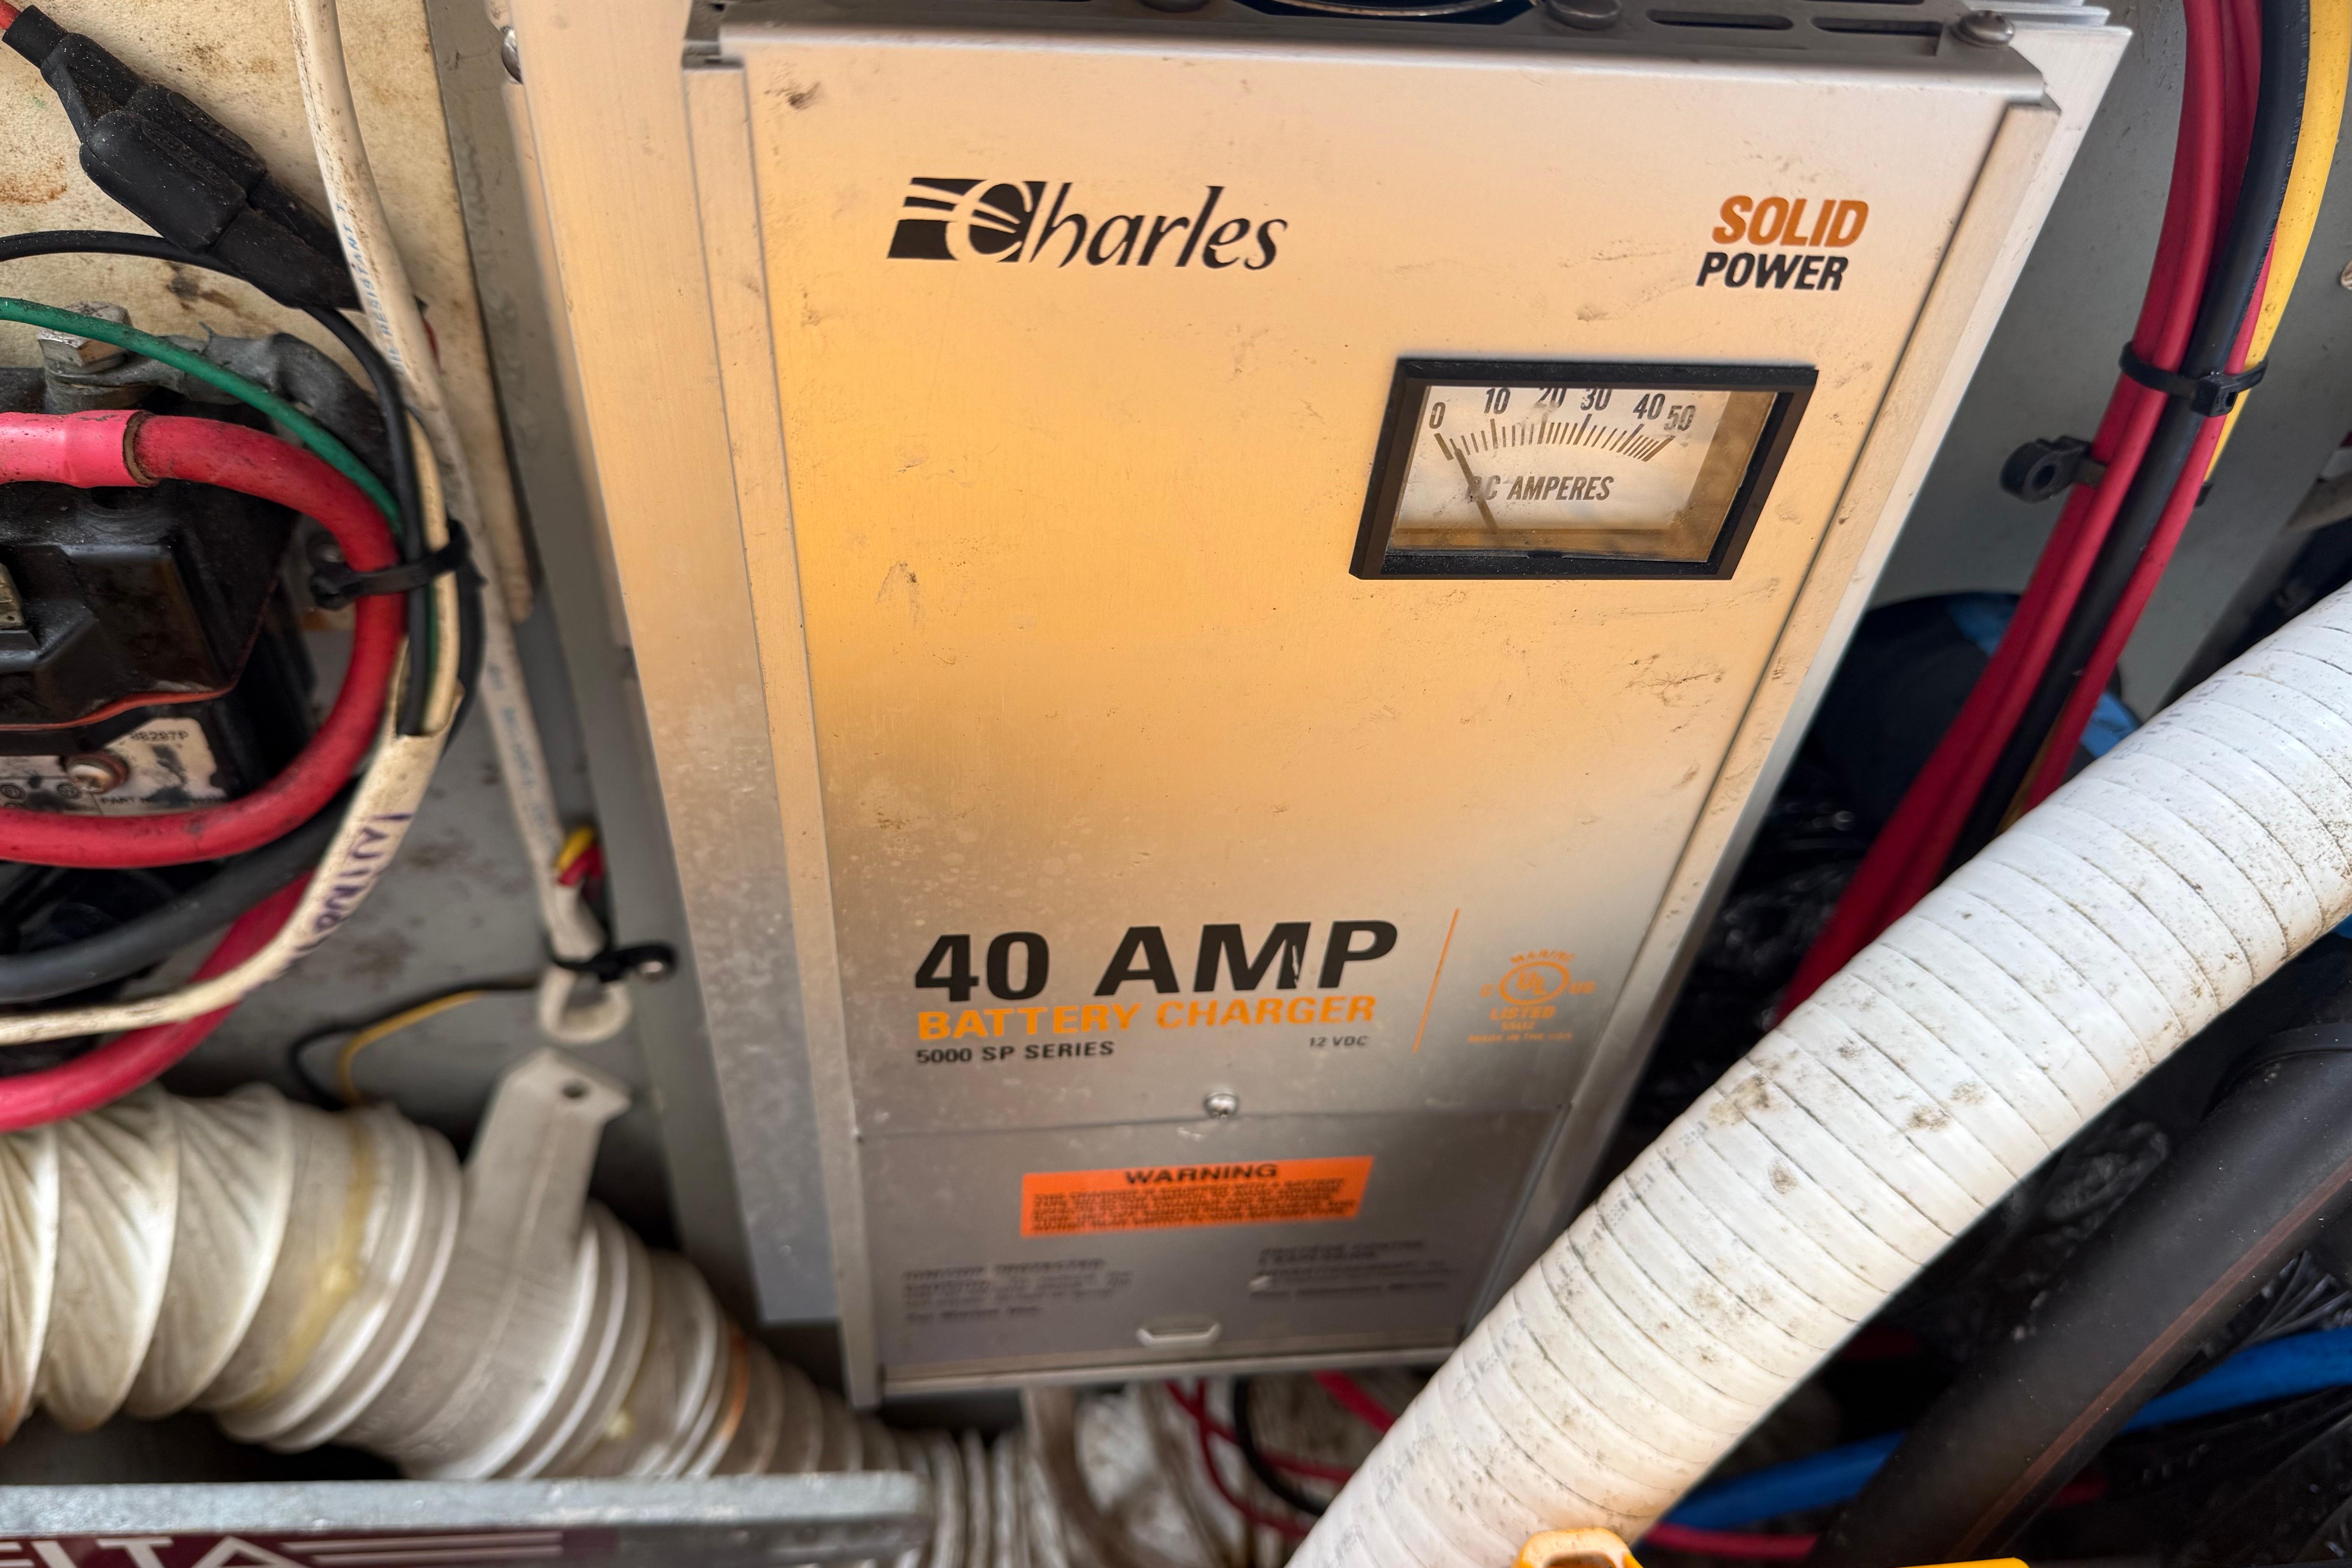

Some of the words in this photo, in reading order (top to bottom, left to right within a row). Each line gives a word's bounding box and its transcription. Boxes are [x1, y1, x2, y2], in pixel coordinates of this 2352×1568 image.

[944, 178, 1288, 271] Charles
[1712, 195, 1869, 247] SOLID
[1695, 251, 1848, 290] POWER
[1429, 402, 1446, 429] 0
[1484, 387, 1511, 414] 10
[1580, 388, 1612, 411] 30
[1633, 393, 1665, 420] 40
[1664, 405, 1696, 431] 50
[1506, 476, 1614, 501] AMPERES
[914, 931, 1050, 1001] 40
[1094, 920, 1398, 996] AMP
[918, 1003, 1142, 1040] BATTERY
[1155, 995, 1376, 1029] CHARGER
[916, 1048, 973, 1064] 5000
[982, 1045, 1015, 1061] SP
[1024, 1041, 1115, 1059] SERIES
[1309, 1036, 1327, 1047] 12
[1331, 1035, 1369, 1046] VDC
[1125, 1164, 1278, 1184] WARNING
